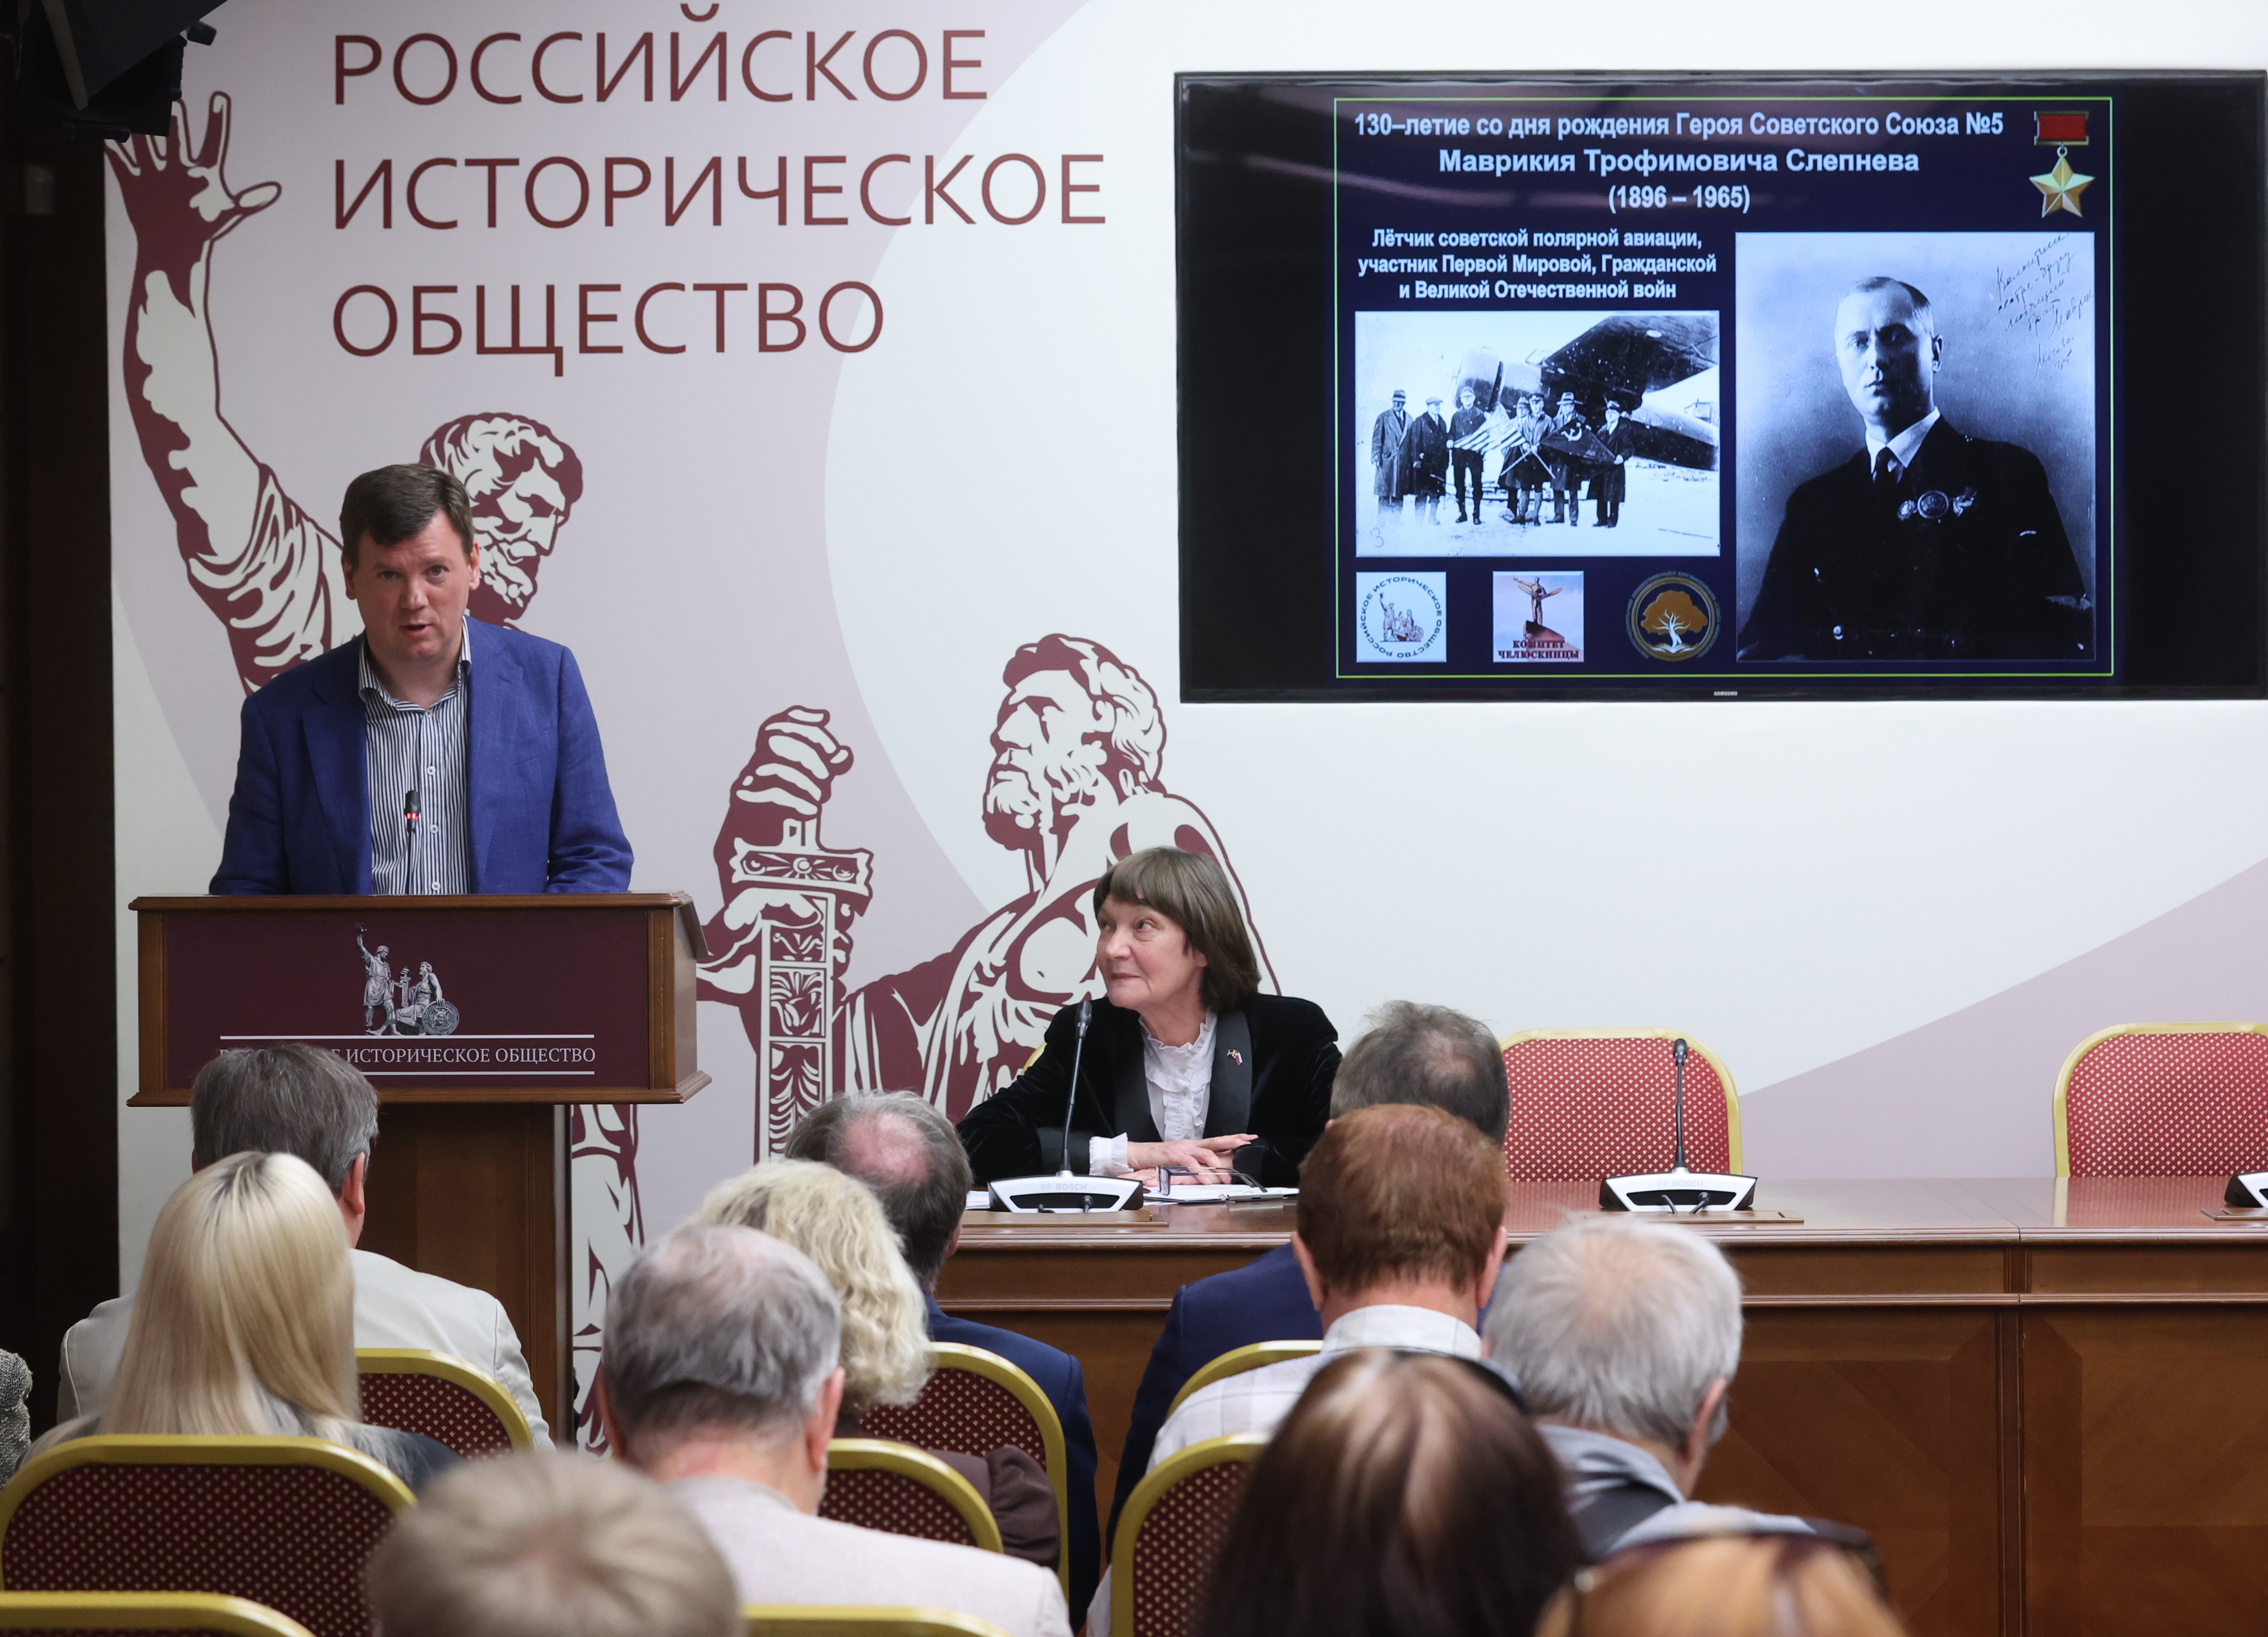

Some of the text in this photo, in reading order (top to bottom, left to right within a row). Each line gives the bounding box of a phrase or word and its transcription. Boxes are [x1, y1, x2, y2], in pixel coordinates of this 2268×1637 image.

[334, 3, 987, 106] РОССИЙСКОЕ
[1476, 117, 1503, 135] со
[1508, 117, 1551, 139] дня
[1557, 117, 1669, 140] рождения
[1676, 112, 1743, 141] Героя
[1749, 111, 1879, 135] Советского
[1885, 111, 1959, 135] Союза
[1966, 112, 2004, 135] №5
[1439, 148, 1919, 177] Маврикия Трофимовича Слепнева
[334, 153, 1106, 231] ИСТОРИЧЕСКОЕ
[1608, 184, 1667, 214] (1896
[1692, 185, 1750, 214] 1965)
[1372, 228, 1702, 251] Лётчик советской полярной авиации,
[1358, 253, 1717, 277] участник Первой Мировой, Гражданской
[1399, 279, 1677, 299] и Великой Отечественной войн
[332, 281, 884, 378] ОБЩЕСТВО
[1360, 576, 1442, 658] РОССИЙСКОЕ ИСТОРИЧЕСКОЕ ОБЩЕСТВО
[1498, 650, 1580, 660] ЧЕЛЮСКИНЦЫ
[1512, 640, 1565, 649] КОМИТЕТ
[346, 1048, 490, 1063] ИСТОРИЧЕСКОЕ
[495, 1047, 596, 1065] ОБЩЕСТВО
[1055, 1183, 1087, 1191] BOSCH
